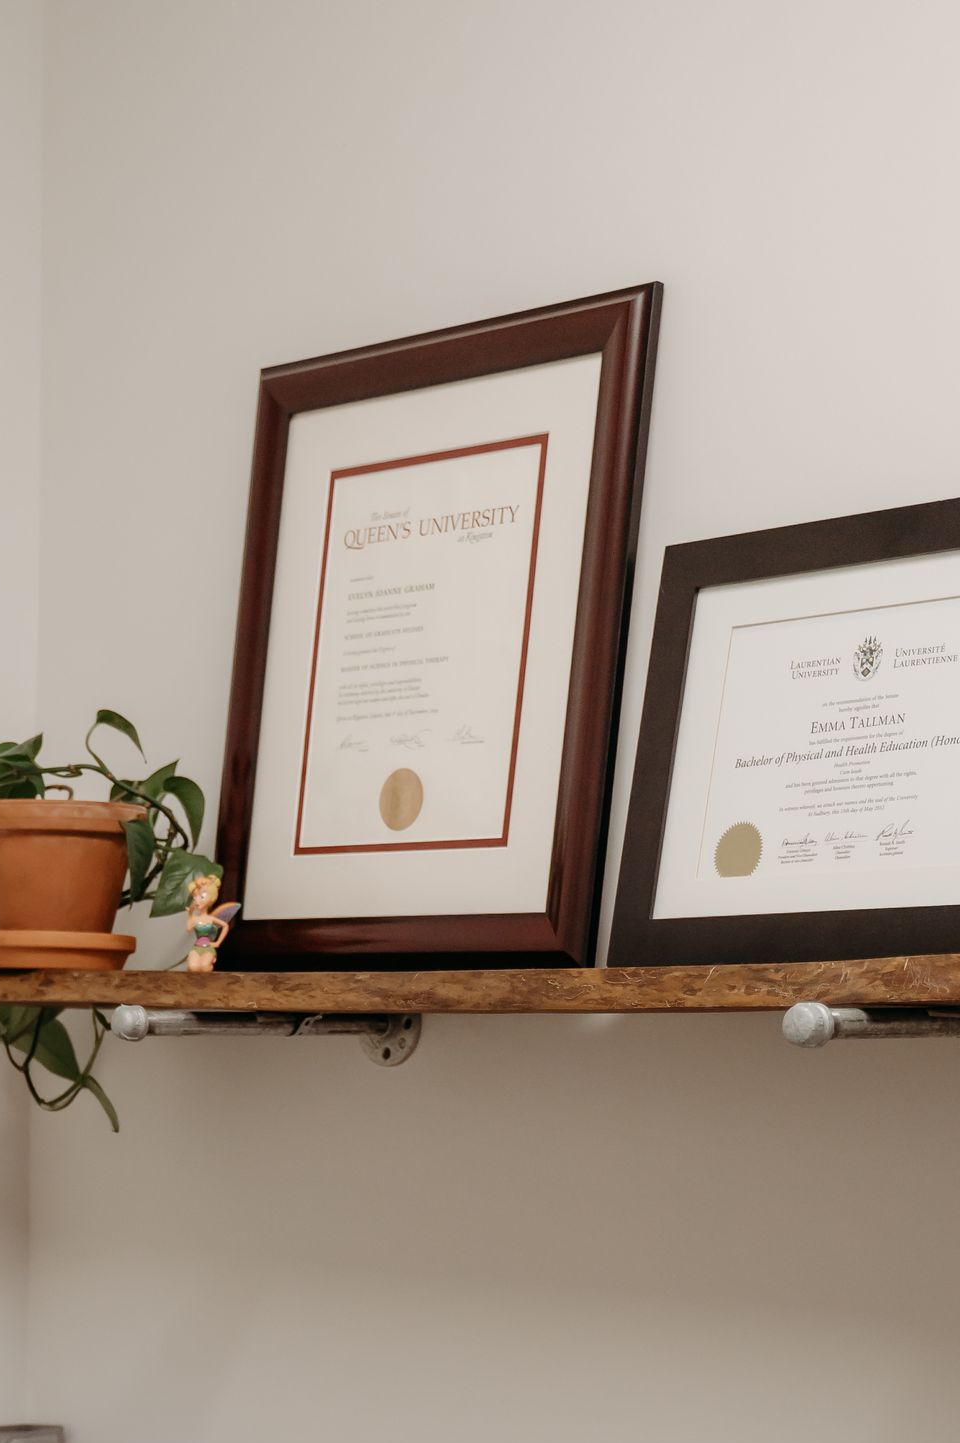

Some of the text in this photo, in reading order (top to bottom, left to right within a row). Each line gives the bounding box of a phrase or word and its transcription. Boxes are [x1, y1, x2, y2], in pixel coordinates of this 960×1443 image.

[343, 505, 520, 550] QUEEN'S UNIVERSITY
[895, 642, 946, 658] UNIVERSITÉ
[790, 657, 842, 670] LAURENTIAN
[893, 654, 959, 669] LAURENTIENNE
[791, 667, 840, 680] UNIVERSITY
[811, 713, 906, 734] EMMA TALLMAN
[734, 756, 773, 769] Bachelor
[774, 753, 786, 767] of
[785, 748, 823, 765] Physical
[824, 746, 843, 759] and
[845, 744, 877, 757] Health
[879, 738, 929, 753] Education
